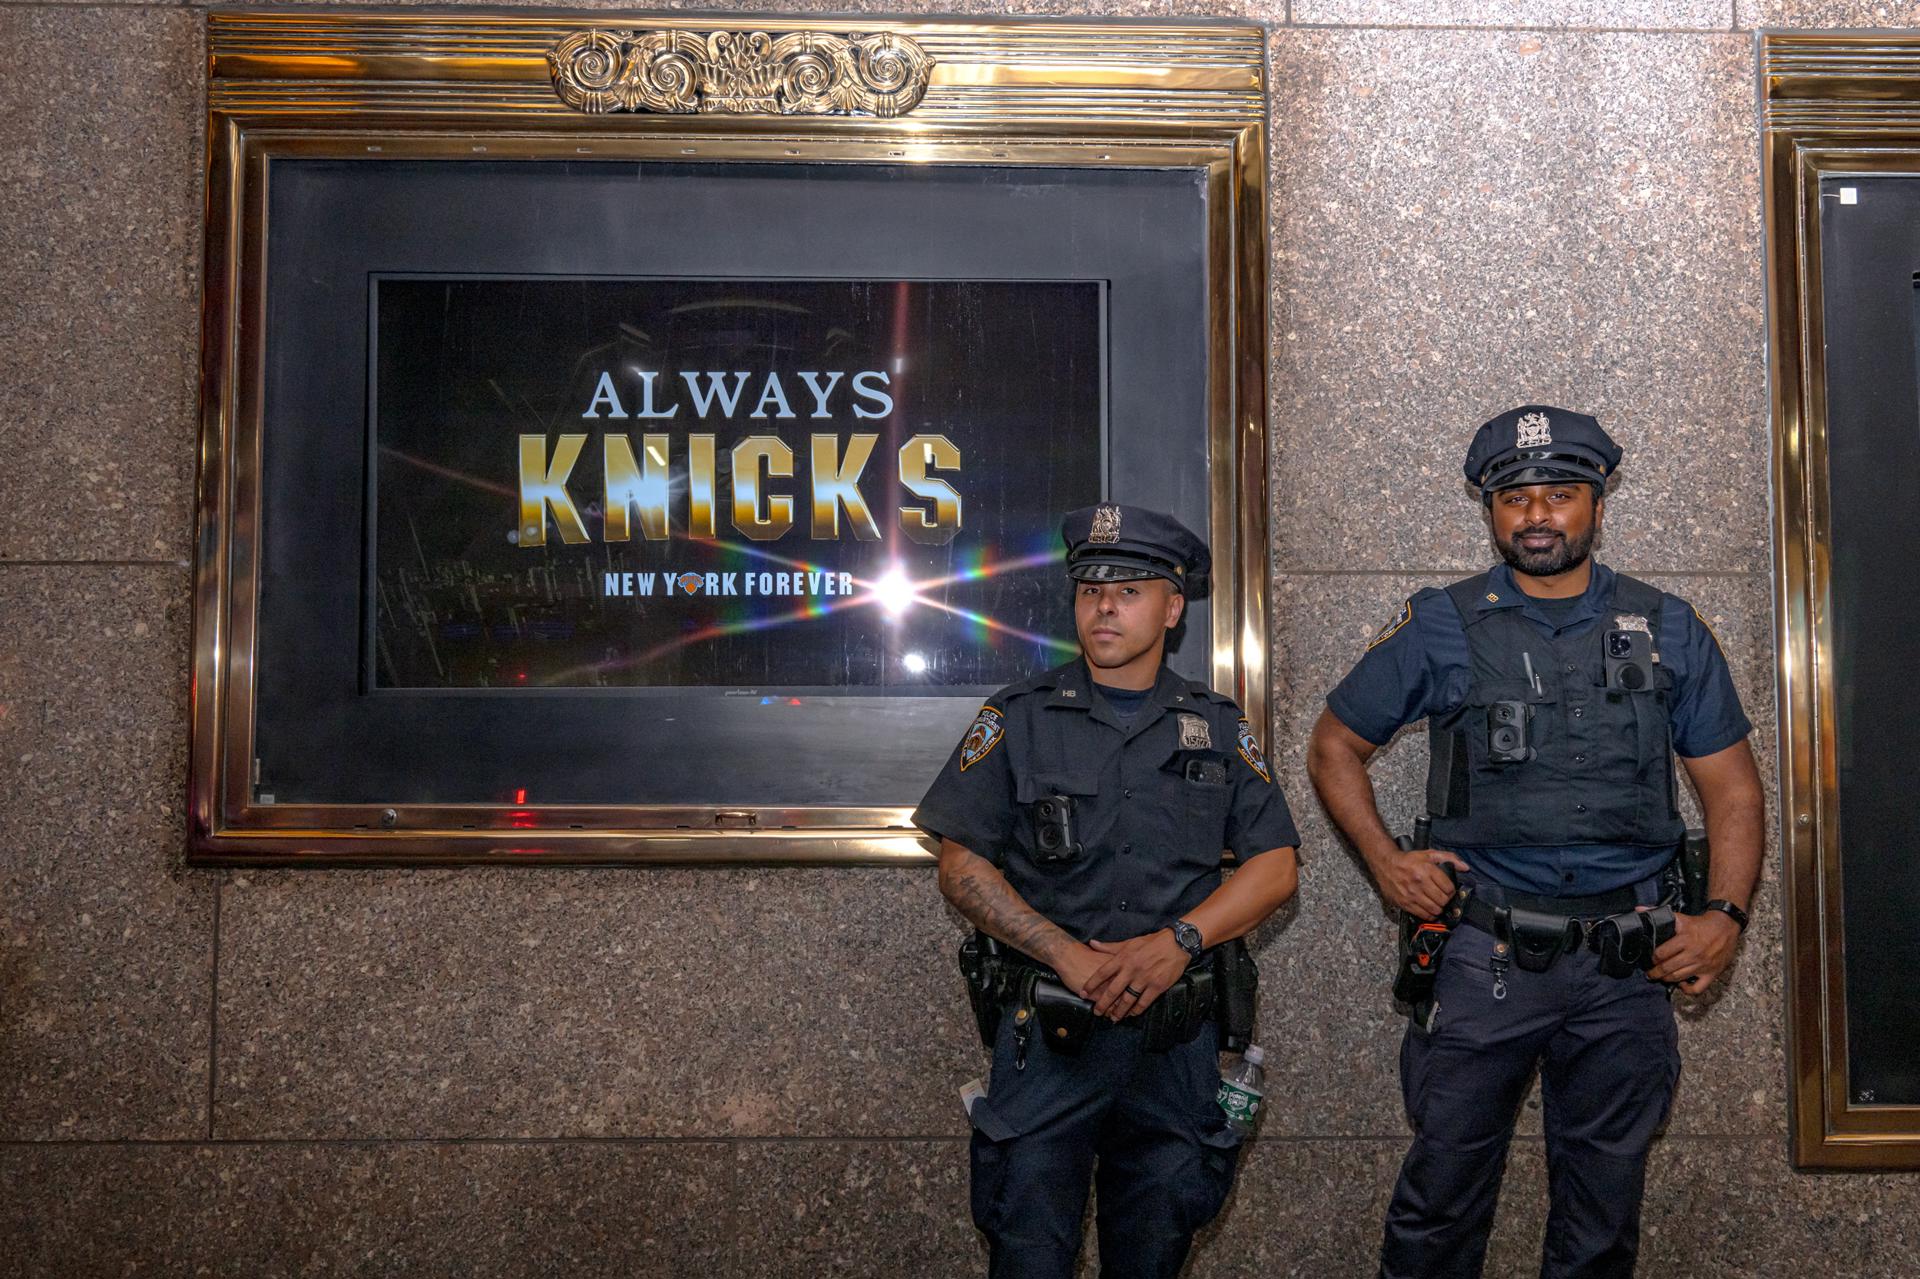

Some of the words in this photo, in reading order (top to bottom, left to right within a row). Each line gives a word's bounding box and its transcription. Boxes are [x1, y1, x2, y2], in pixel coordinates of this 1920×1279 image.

[582, 371, 895, 420] ALWAYS
[518, 432, 962, 547] KNICKS
[605, 572, 656, 597] NEW
[745, 571, 853, 597] FOREVER
